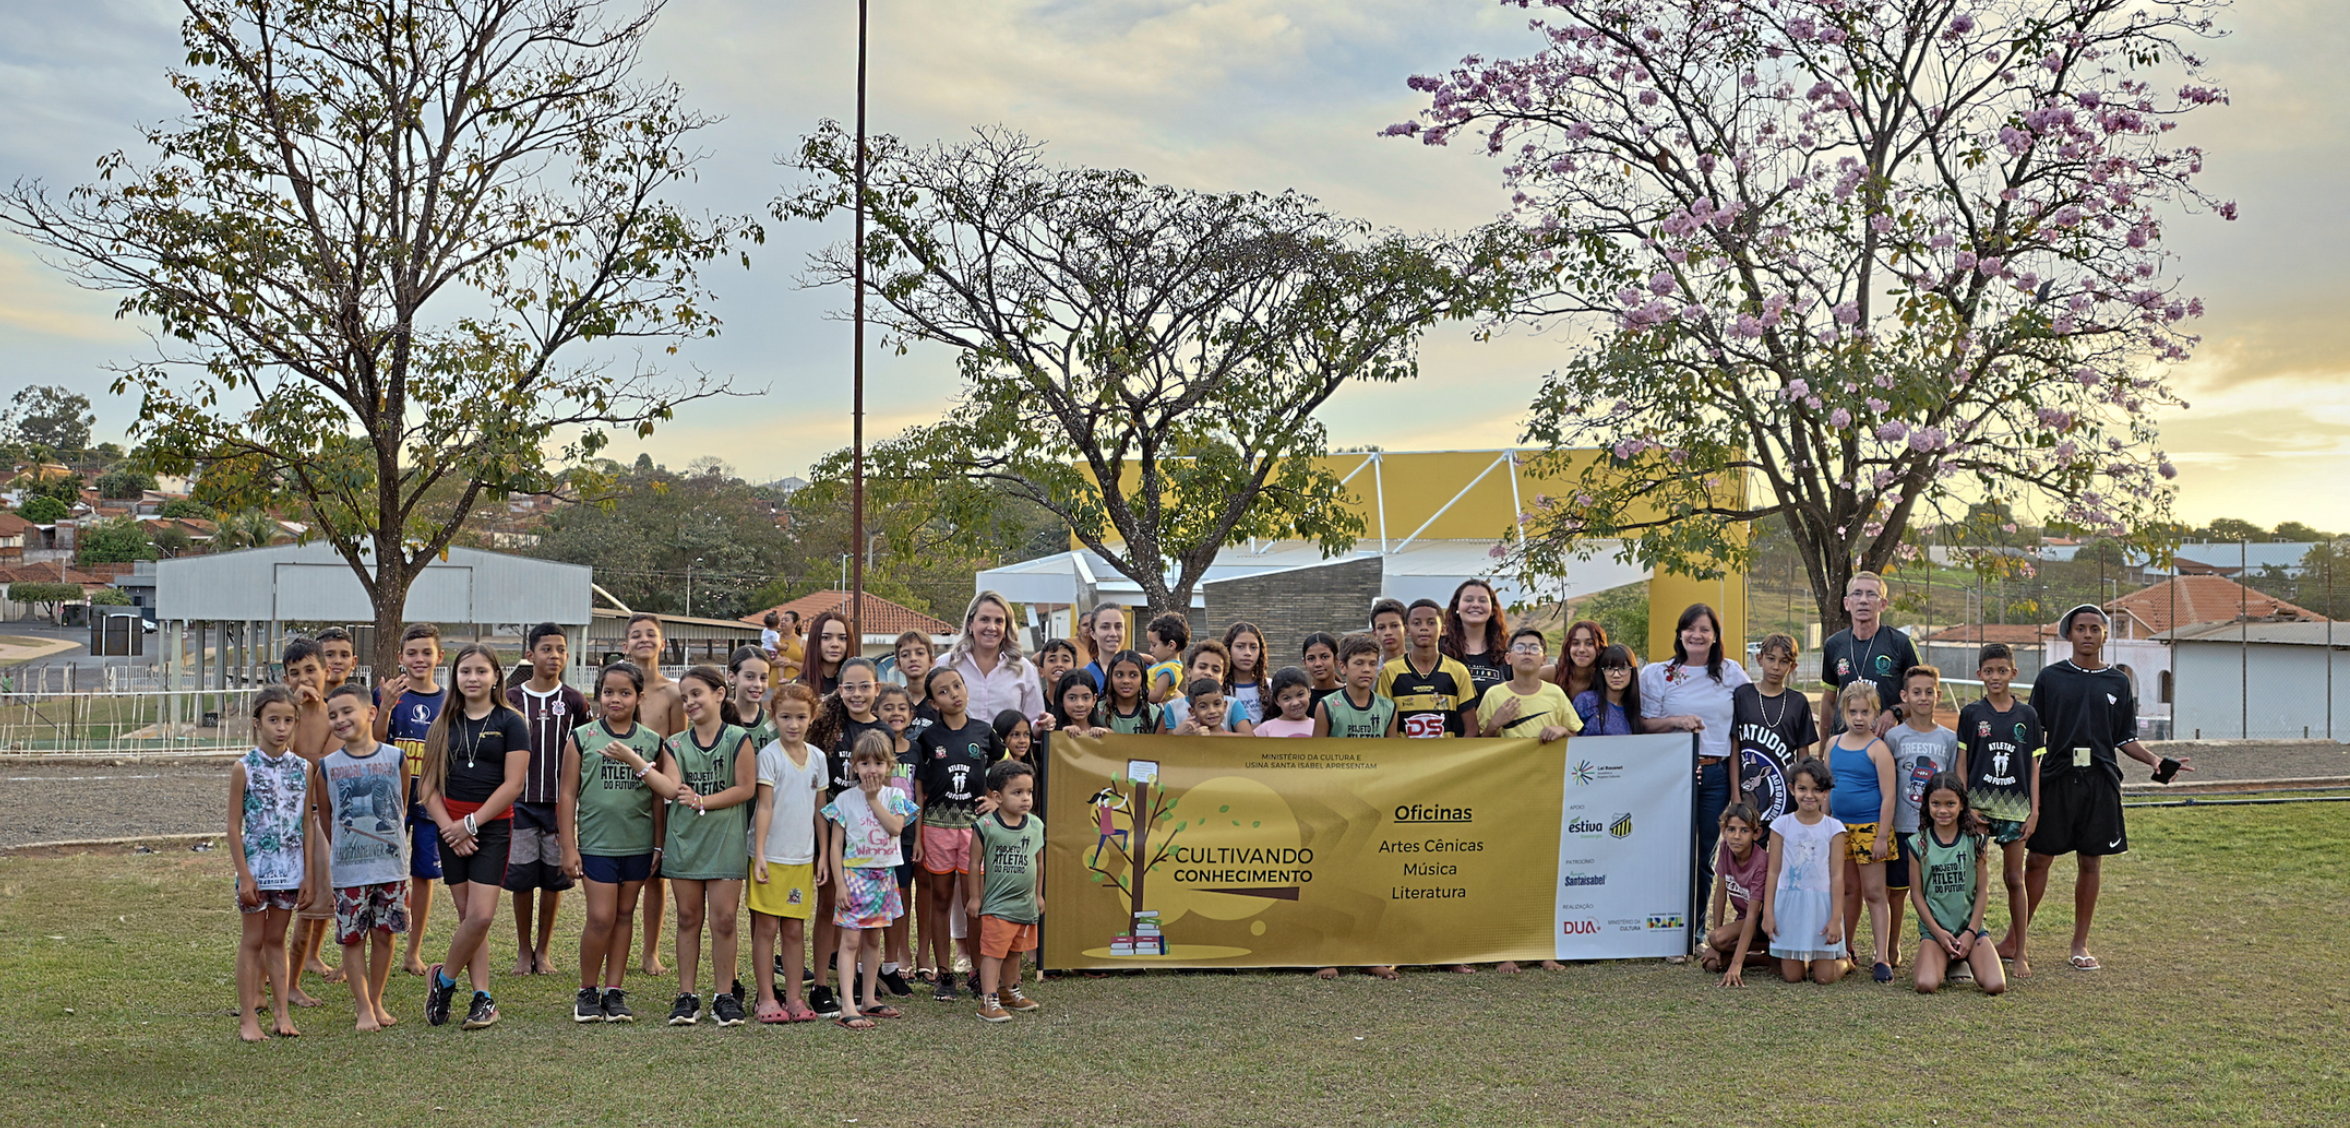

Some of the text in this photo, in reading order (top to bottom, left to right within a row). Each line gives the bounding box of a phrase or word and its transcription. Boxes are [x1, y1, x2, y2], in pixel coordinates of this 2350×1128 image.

[1406, 718, 1443, 737] DS
[1901, 742, 1947, 757] FREESTYLE
[1988, 741, 2016, 753] ATLETAS
[1261, 753, 1306, 761] MINISTÉRIO
[1325, 762, 1377, 770] APRESENTAM
[601, 766, 642, 781] ATLETA
[1983, 773, 2016, 786] DO FUTURO
[604, 781, 640, 790] DO FUTURO
[1394, 804, 1473, 821] Oficinas
[1568, 819, 1603, 833] estiva
[996, 846, 1021, 854] PROJETO
[1378, 838, 1484, 853] Artes Cênicas
[993, 854, 1029, 867] ATLETAS
[1175, 847, 1314, 864] CULTIVANDO
[1003, 866, 1026, 875] FUTURO
[1403, 862, 1457, 876] Música
[1930, 862, 1958, 872] PROJETO
[1173, 869, 1313, 883] CONHECIMENTO
[1392, 886, 1466, 900] Literatura
[1934, 885, 1944, 894] DO
[1646, 916, 1684, 929] BRASIL
